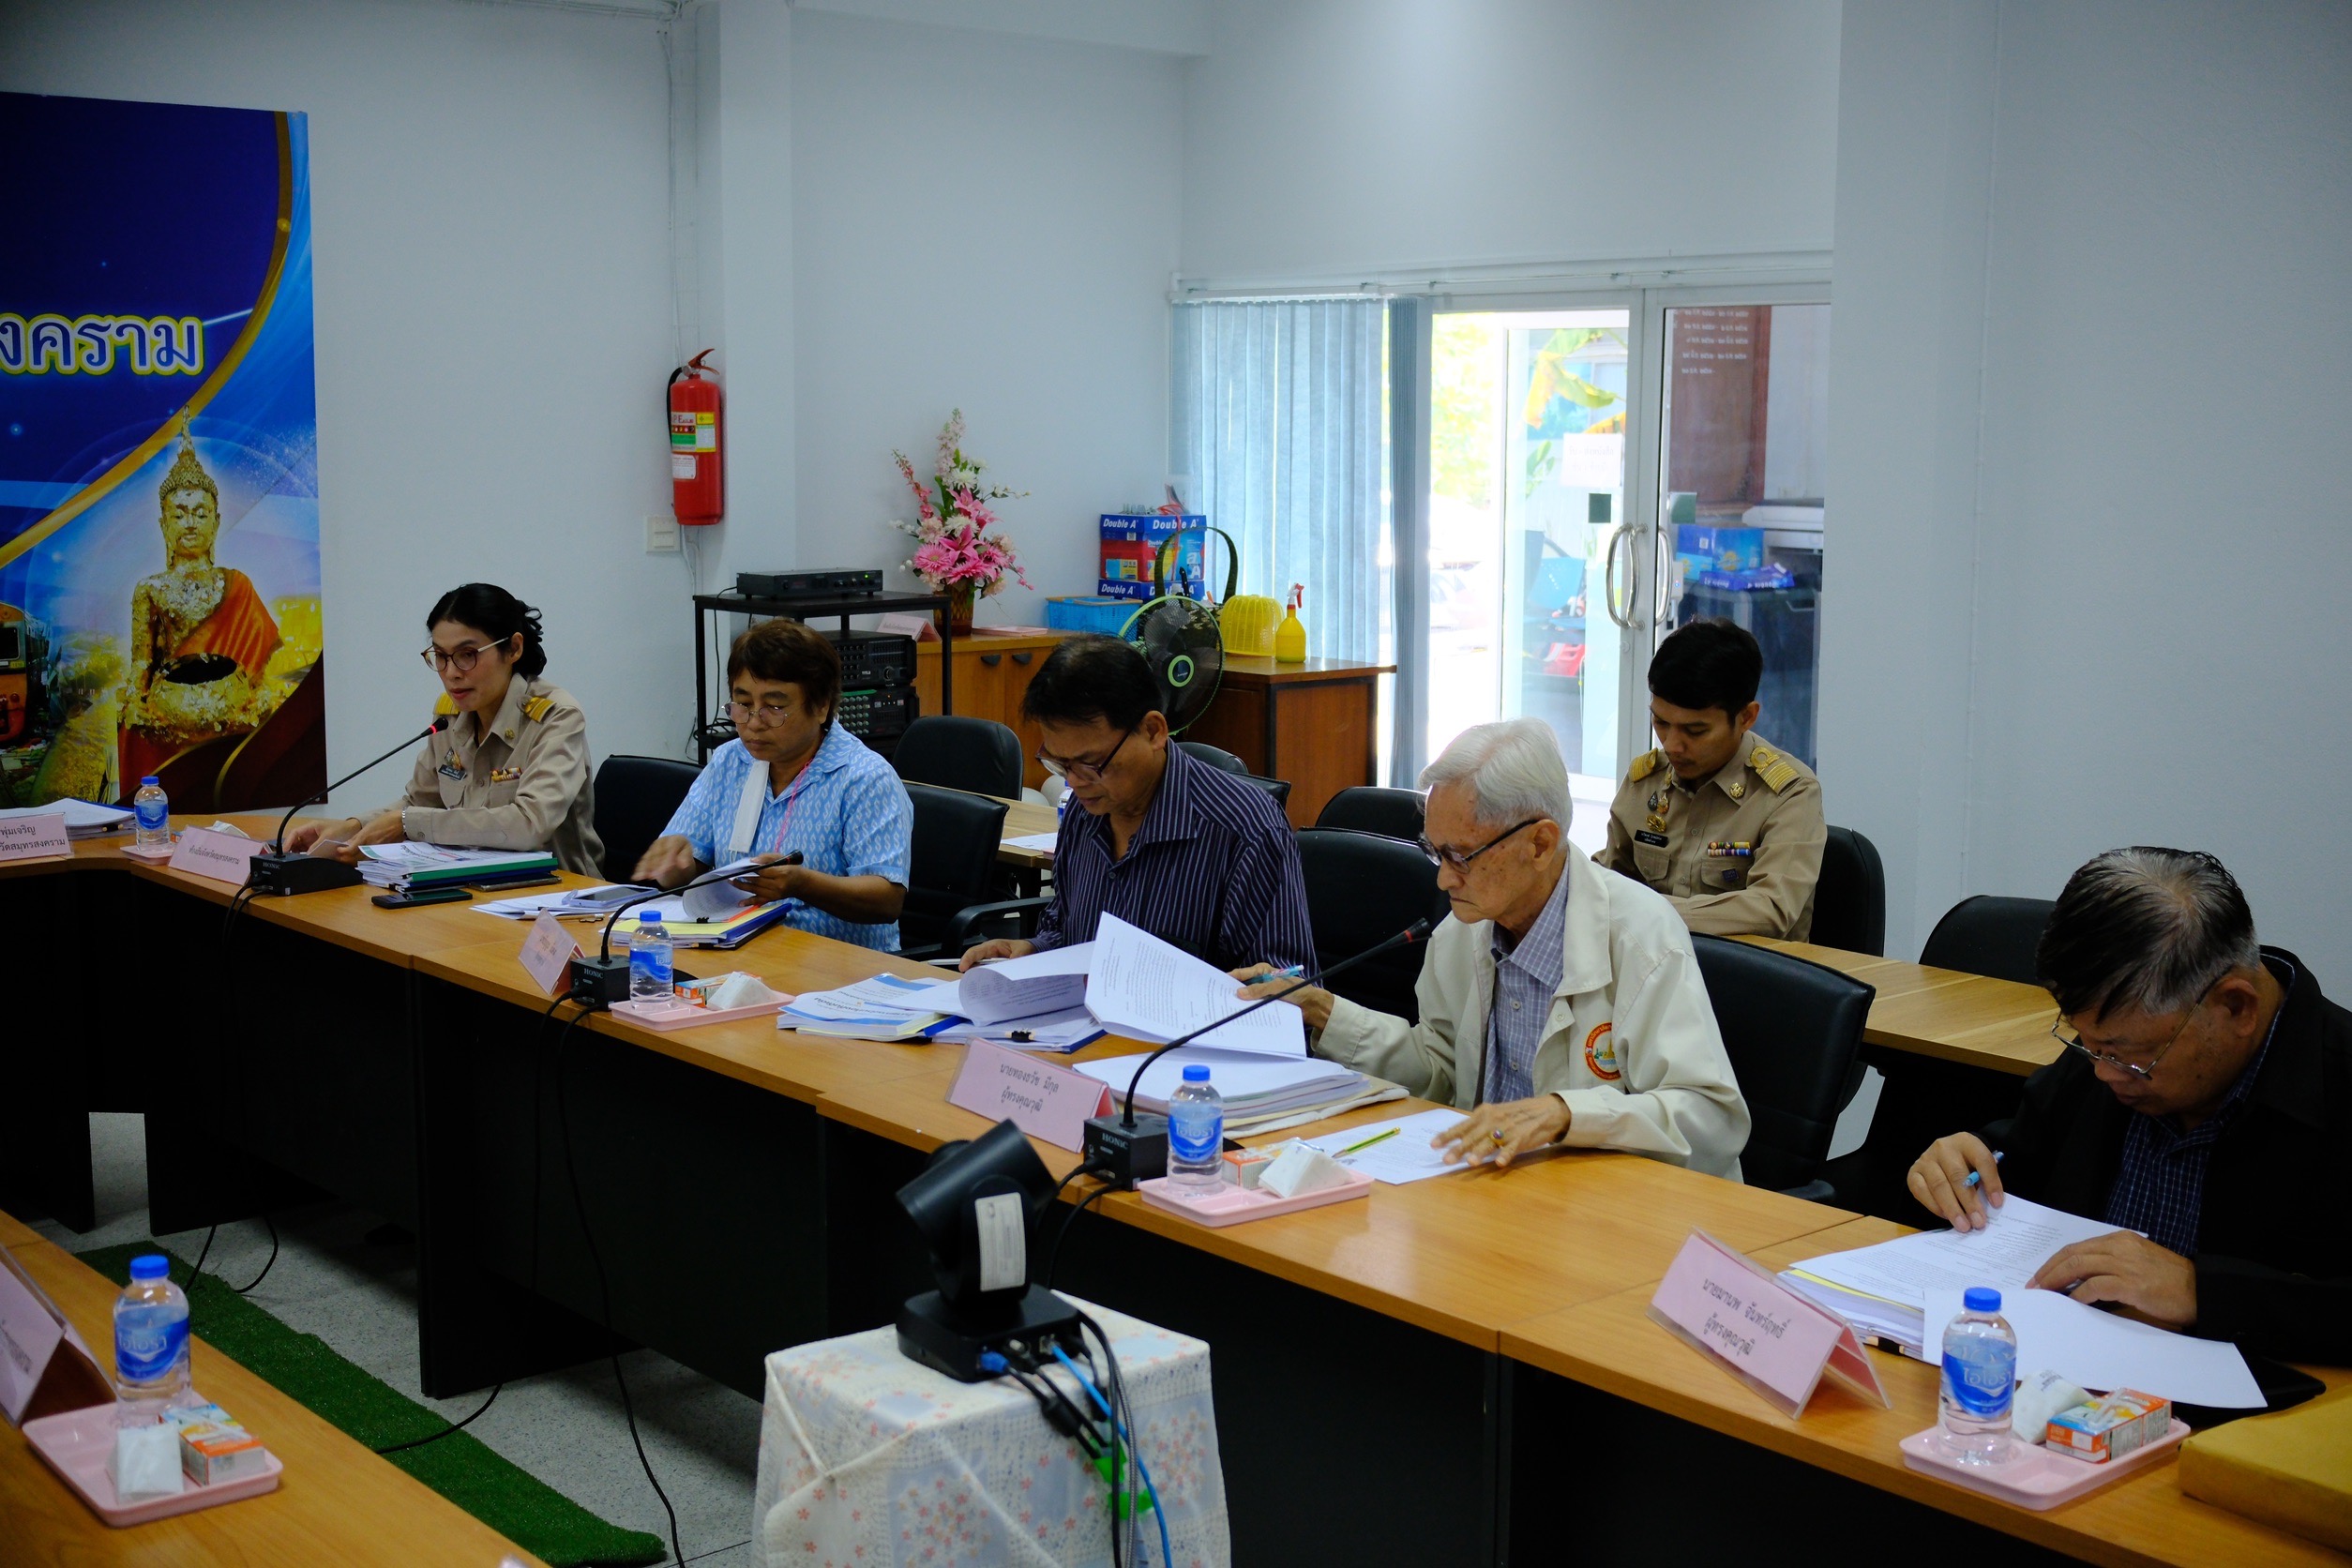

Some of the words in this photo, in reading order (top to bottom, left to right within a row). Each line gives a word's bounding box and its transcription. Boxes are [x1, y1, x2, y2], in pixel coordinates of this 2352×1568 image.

[0, 317, 200, 371] งคราม
[1103, 518, 1129, 529] Double
[1130, 520, 1137, 529] A
[1153, 519, 1187, 530] Doube
[1190, 519, 1198, 529] A
[1101, 583, 1126, 595] Double
[1127, 585, 1134, 595] A
